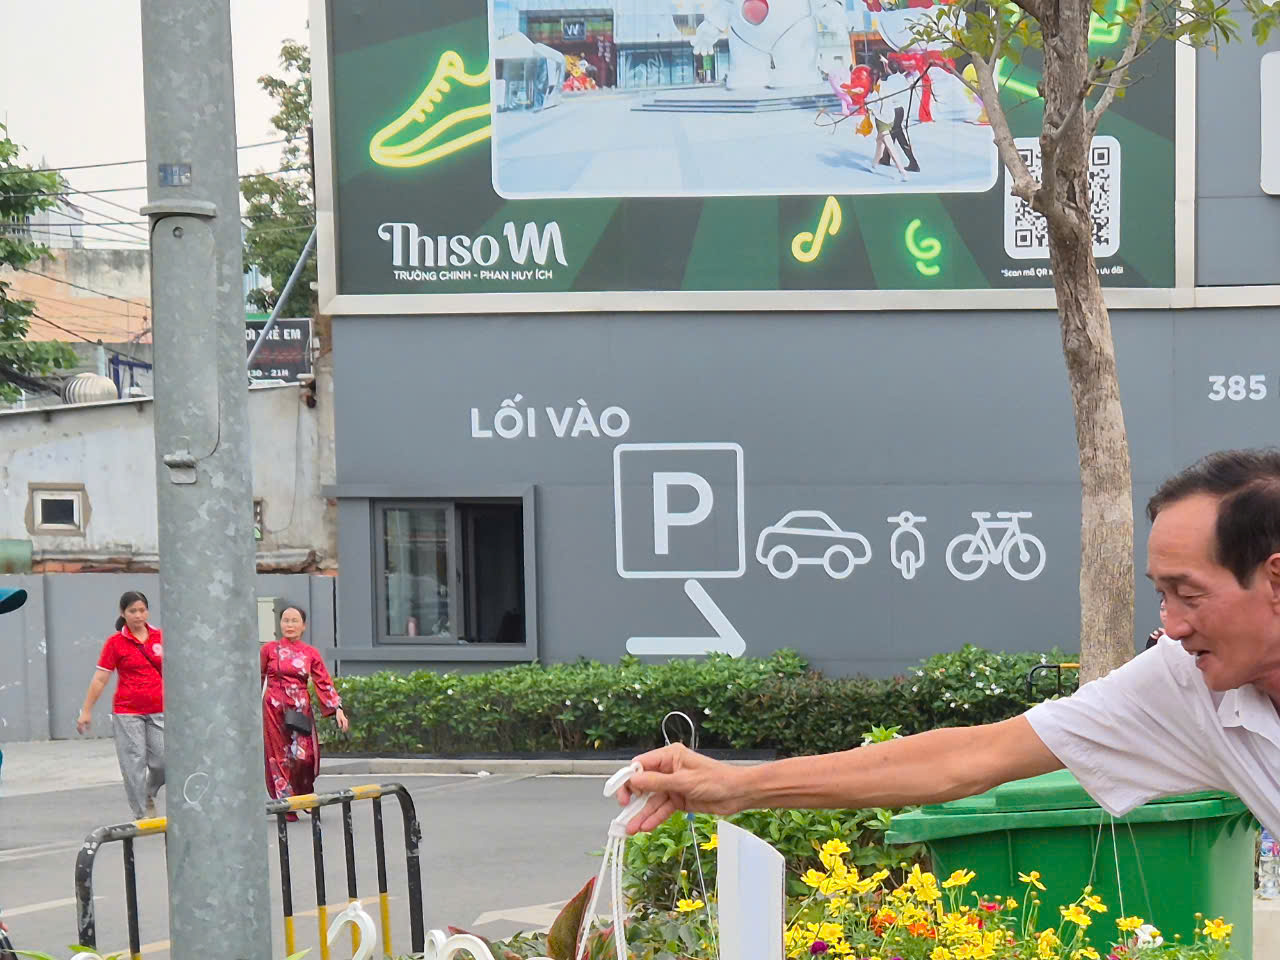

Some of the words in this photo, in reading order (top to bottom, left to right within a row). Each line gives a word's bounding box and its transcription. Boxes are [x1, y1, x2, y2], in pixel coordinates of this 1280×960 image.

[393, 269, 437, 281] TRƯỜNG
[439, 270, 471, 280] CHINH
[480, 270, 509, 280] PHAN
[511, 270, 533, 280] HUY
[535, 268, 553, 280] ÍCH
[1036, 267, 1048, 278] QR
[284, 328, 301, 340] EM
[1207, 374, 1268, 401] 385
[470, 393, 536, 438] LỐI
[545, 398, 630, 438] VÀO
[652, 471, 714, 555] P
